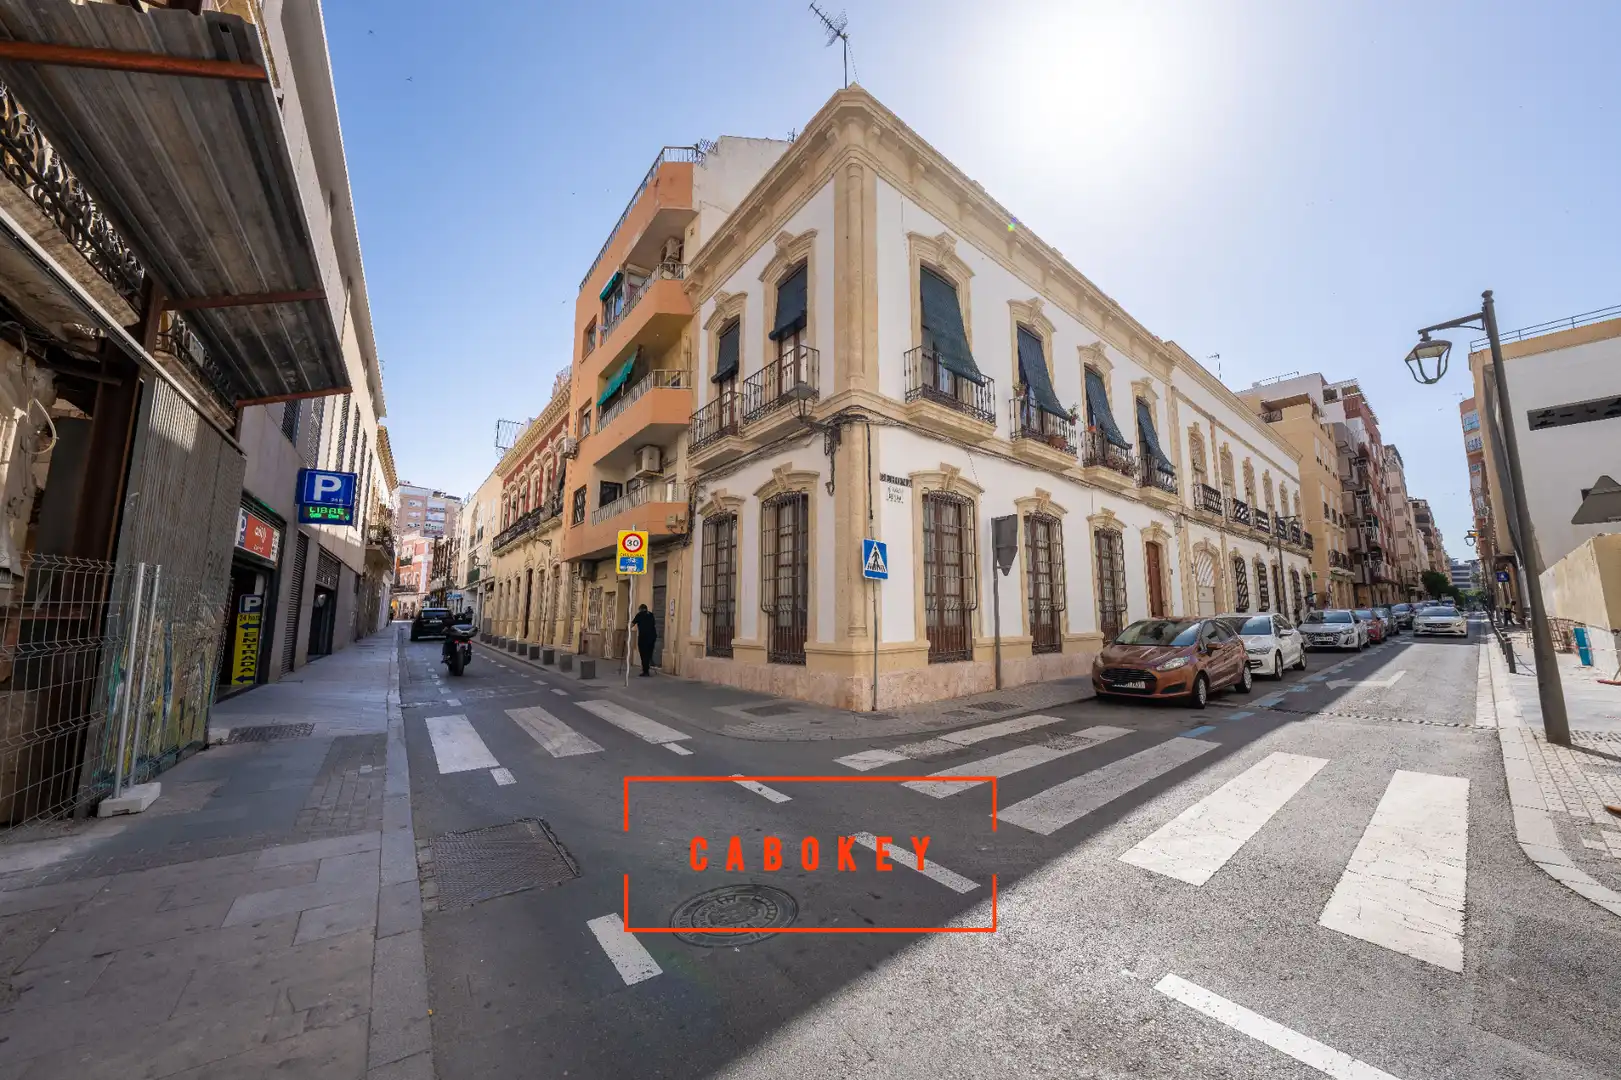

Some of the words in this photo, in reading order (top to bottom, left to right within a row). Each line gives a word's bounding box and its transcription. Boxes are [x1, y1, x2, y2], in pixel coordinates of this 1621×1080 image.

[313, 474, 342, 501] P
[309, 506, 345, 515] LIBRE
[626, 539, 639, 547] 30
[244, 596, 262, 611] P
[240, 632, 257, 673] ENTRADA
